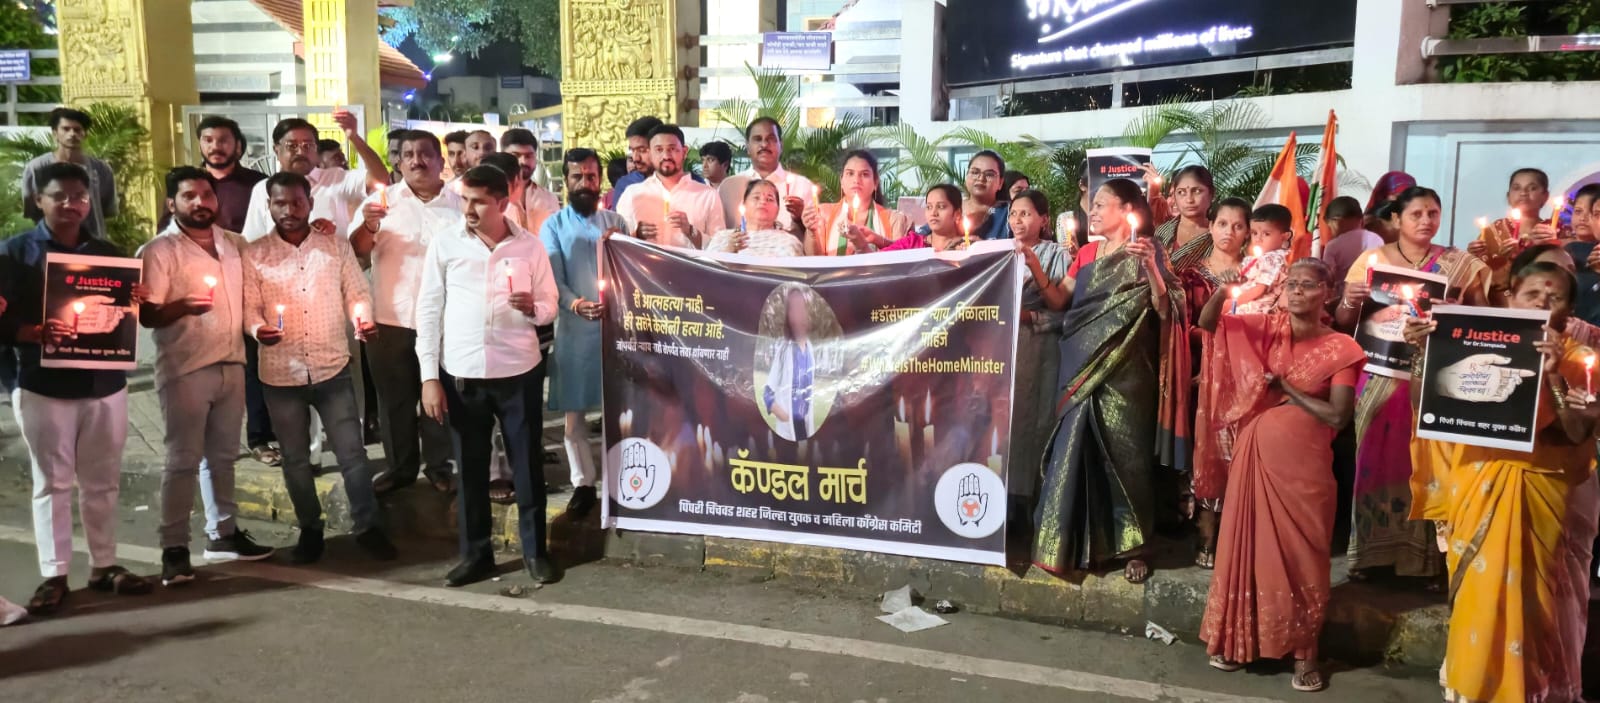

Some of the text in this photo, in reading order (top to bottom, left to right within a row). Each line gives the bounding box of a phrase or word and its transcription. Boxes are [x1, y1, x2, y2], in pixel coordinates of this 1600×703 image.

[1010, 24, 1253, 70] Signature that changed millions of lives
[1100, 164, 1137, 174] # Justice
[77, 275, 122, 287] Justice
[642, 294, 684, 312] आत्महत्या
[685, 295, 703, 314] नाही
[623, 311, 633, 331] ही
[652, 314, 680, 336] केलेली
[682, 320, 704, 337] हत्या
[705, 318, 725, 339] आहे.
[921, 326, 948, 348] पाहिजे
[1452, 328, 1520, 344] # Justice
[860, 355, 1005, 375] #WheIsTheHomeMinister
[729, 449, 868, 504] कॅण्डल मार्च
[736, 506, 758, 520] शहर
[759, 507, 786, 522] जिल्हा
[788, 511, 812, 526] युवक
[813, 514, 821, 525] व
[822, 513, 855, 528] महिला
[856, 514, 888, 531] काँग्रेस
[890, 519, 922, 534] कमिटी
